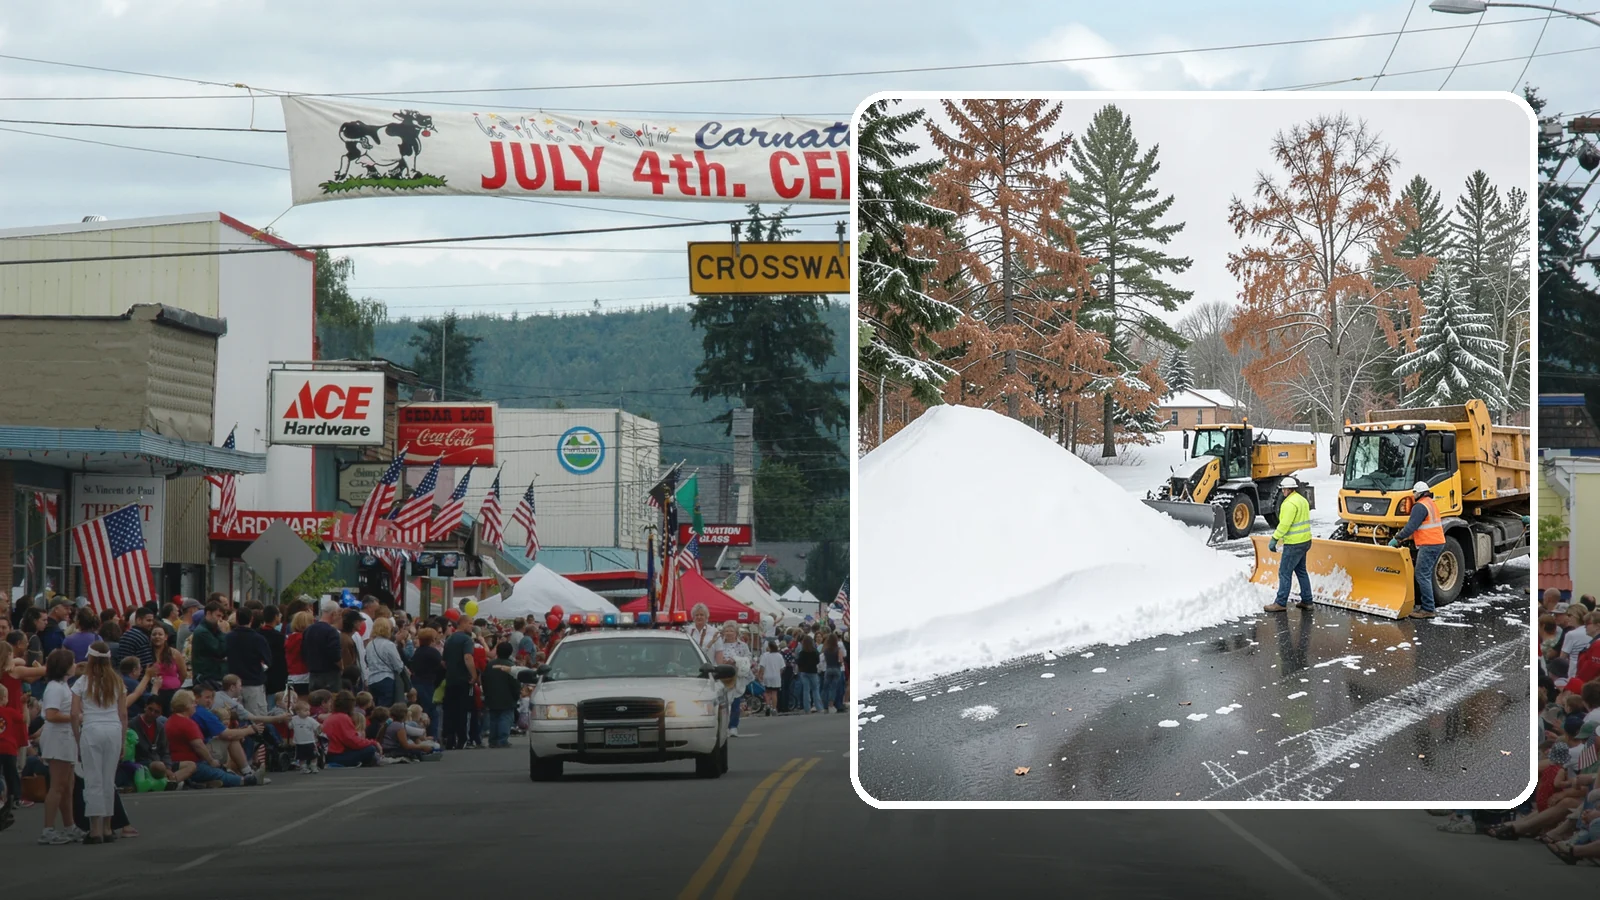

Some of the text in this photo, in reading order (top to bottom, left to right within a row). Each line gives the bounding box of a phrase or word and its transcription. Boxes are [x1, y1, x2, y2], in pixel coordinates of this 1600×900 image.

[481, 140, 605, 192] JULY
[632, 150, 747, 197] 4th.
[697, 254, 850, 280] CROSSWA
[282, 379, 374, 420] ACE
[405, 409, 453, 422] CEDAR
[283, 421, 371, 436] Hardware
[416, 428, 478, 447] Coca-Cola
[96, 485, 124, 495] Vincent
[126, 486, 136, 495] de
[138, 486, 155, 495] Paul
[212, 516, 330, 535] HARDARE
[688, 527, 741, 535] CRNATION
[699, 535, 730, 543] GLASS
